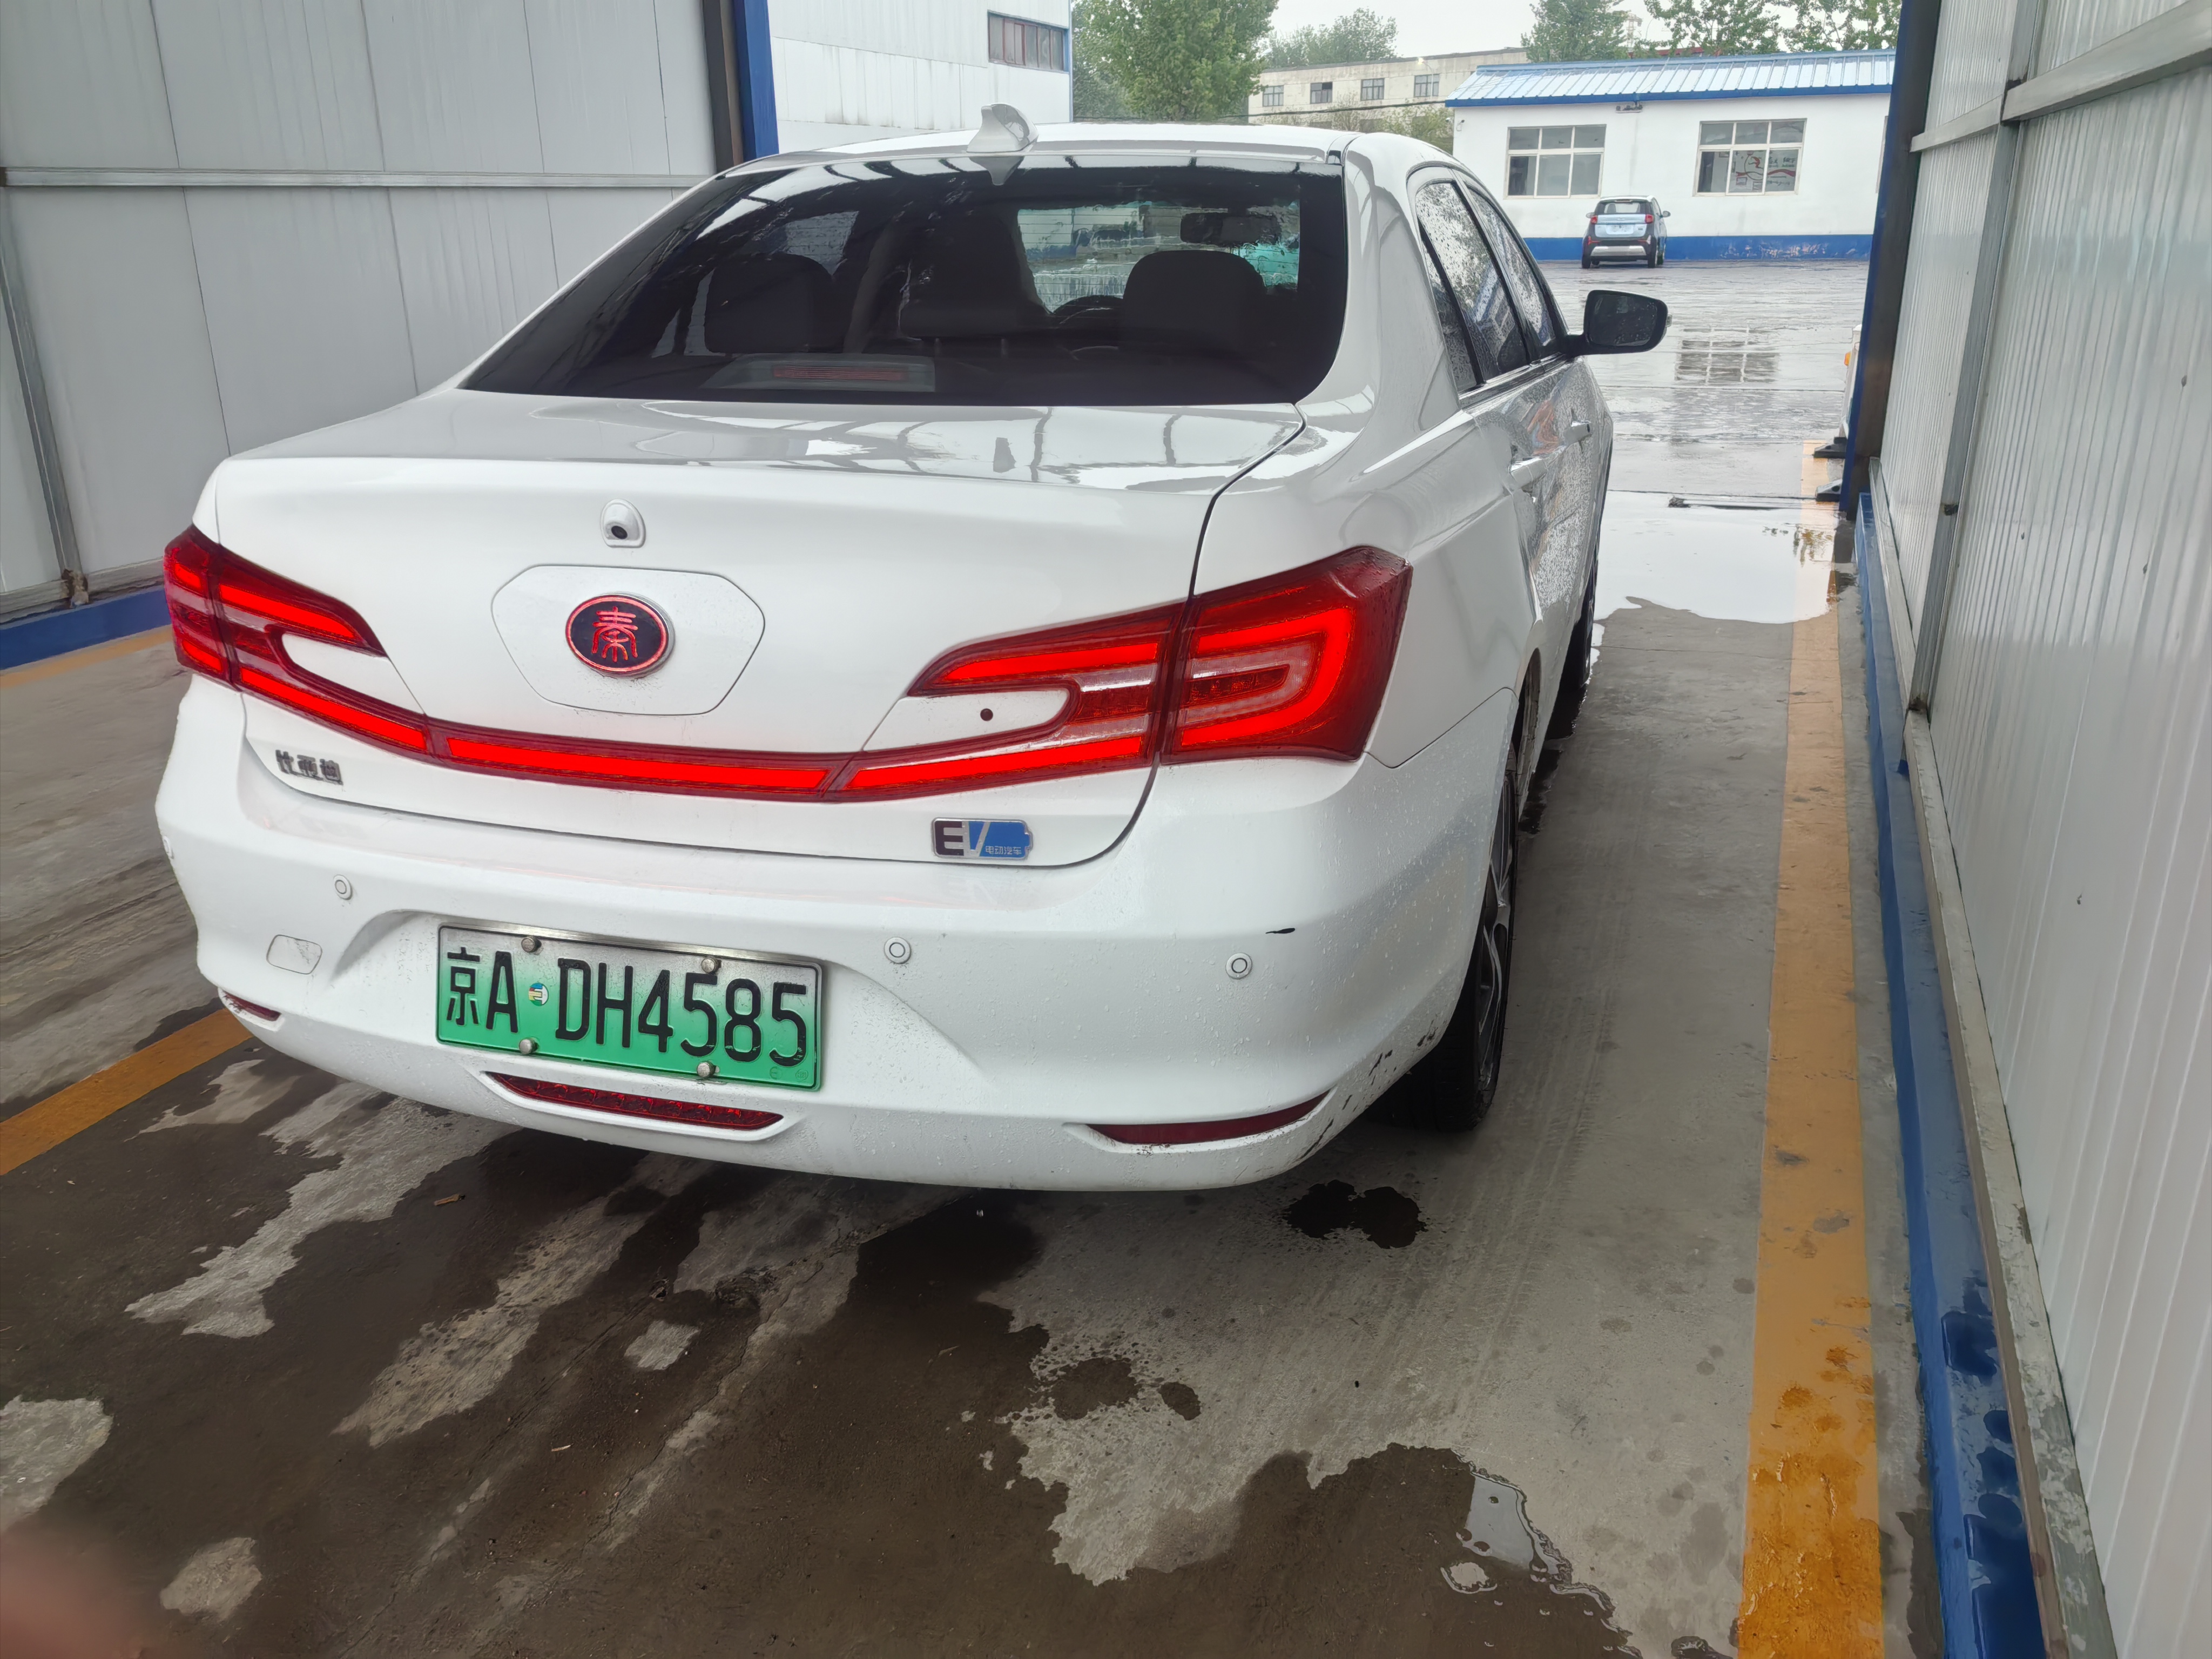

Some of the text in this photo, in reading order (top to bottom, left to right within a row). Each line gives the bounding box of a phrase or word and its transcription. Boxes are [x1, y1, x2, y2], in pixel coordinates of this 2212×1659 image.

[591, 606, 638, 662] 秦
[275, 750, 343, 785] 比亚迪
[934, 820, 991, 857] EV
[985, 845, 1022, 855] 电动汽车
[447, 947, 807, 1067] 京A DH4585
